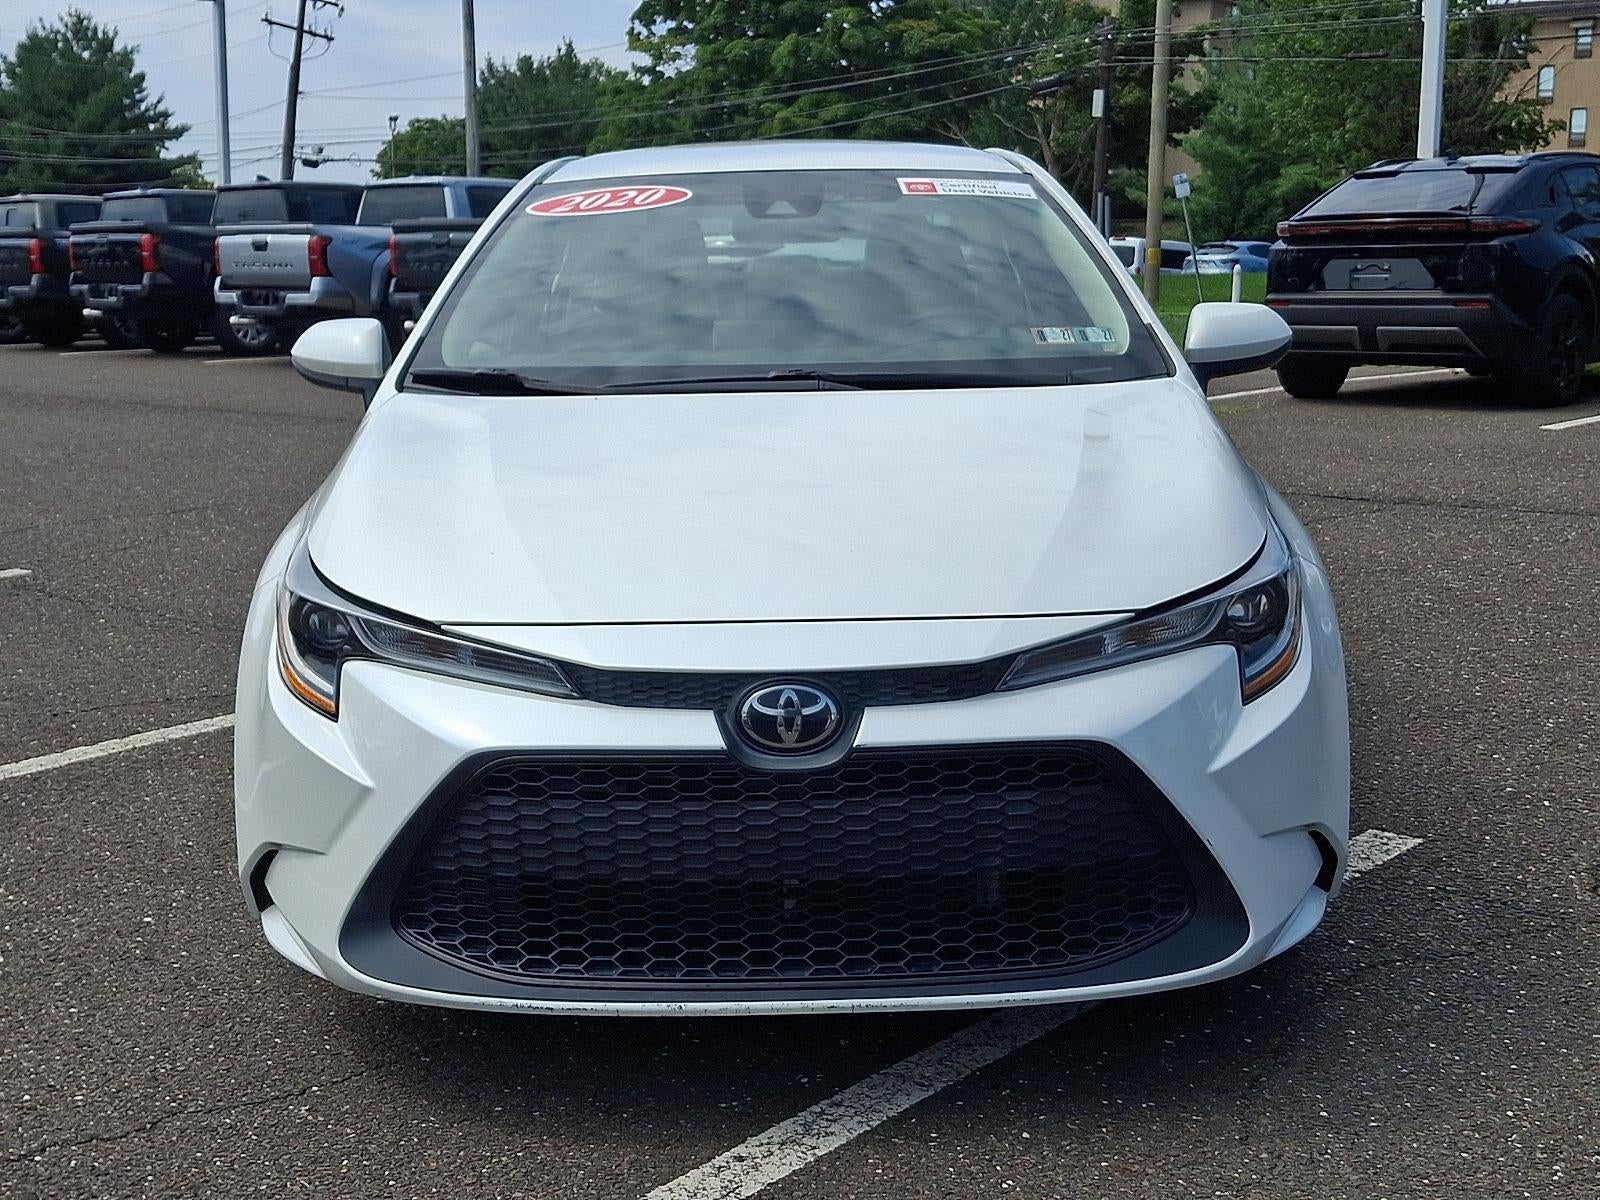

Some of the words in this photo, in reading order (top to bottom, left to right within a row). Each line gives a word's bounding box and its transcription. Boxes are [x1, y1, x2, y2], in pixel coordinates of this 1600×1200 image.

[940, 182, 998, 190] Certified
[978, 189, 1033, 198] Vehicles
[549, 188, 667, 214] 2020
[232, 261, 294, 271] TACOMA
